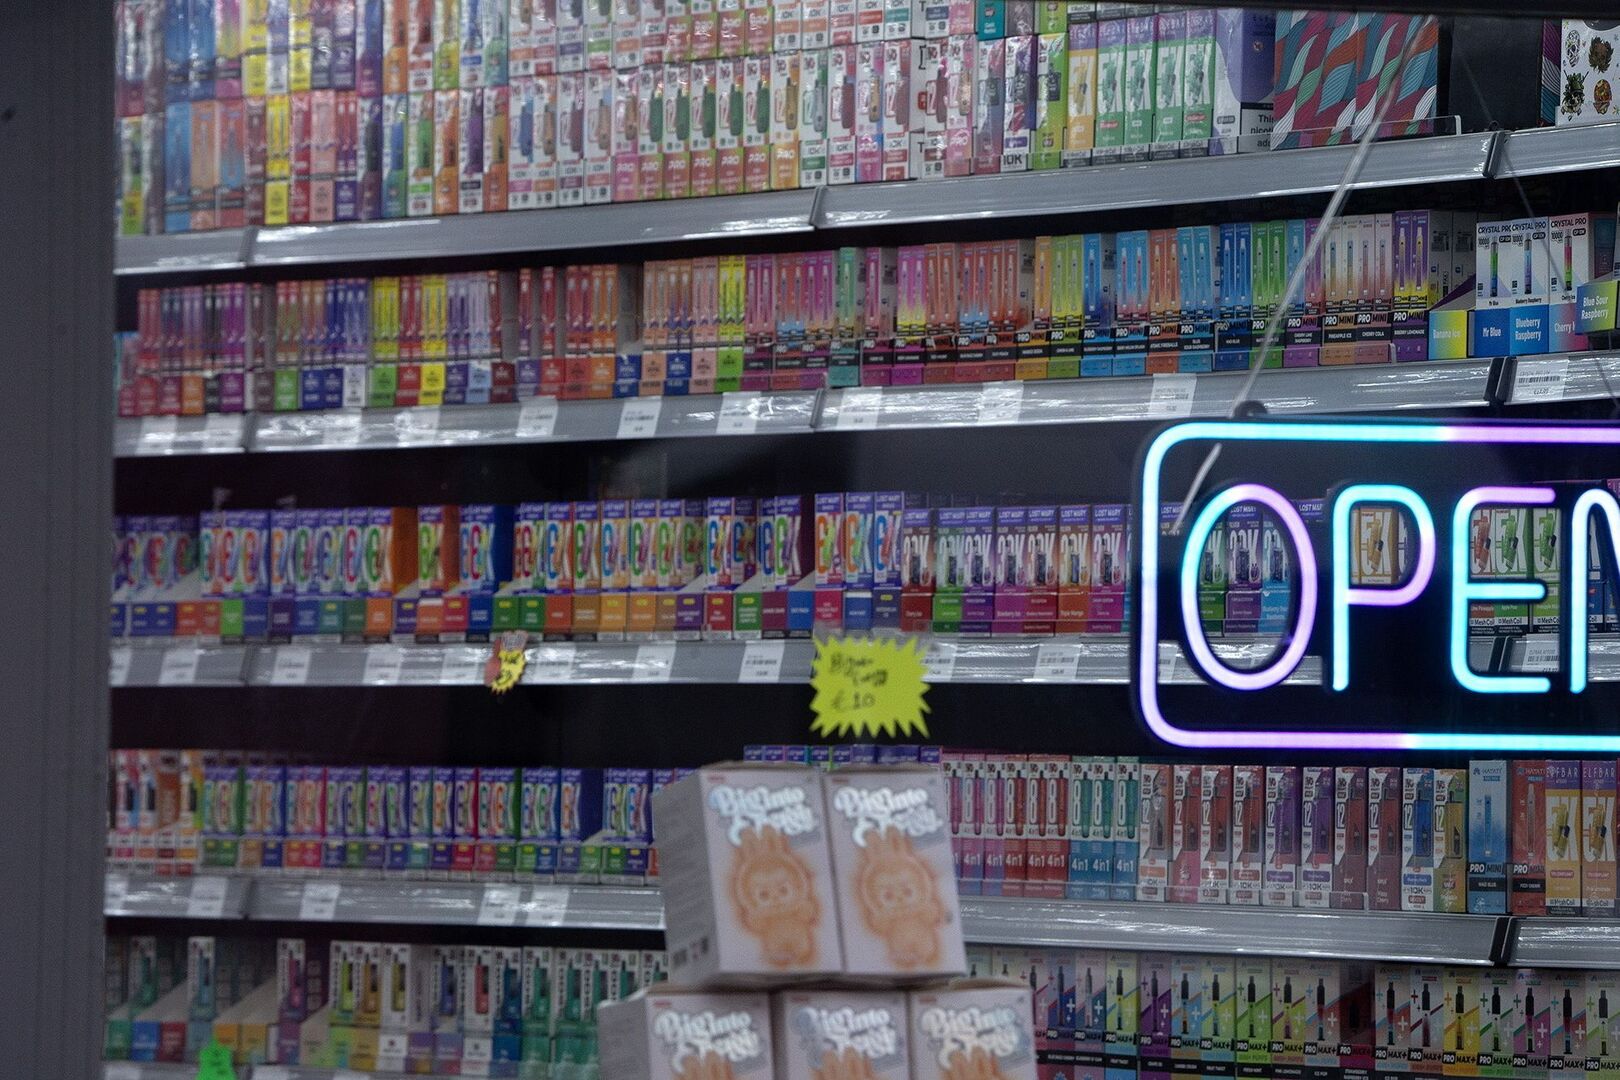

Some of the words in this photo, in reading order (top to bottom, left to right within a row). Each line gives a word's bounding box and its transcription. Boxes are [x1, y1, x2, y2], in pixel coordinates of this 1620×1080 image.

[1003, 154, 1023, 166] 10K
[1512, 224, 1533, 232] CRYSTAL
[1535, 221, 1546, 230] PRO
[1551, 220, 1573, 228] CRYSTAL
[1575, 217, 1586, 226] PRO
[1478, 226, 1500, 234] CRYSTAL
[1583, 297, 1595, 307] Blue
[1596, 295, 1609, 305] Sour
[1357, 314, 1371, 323] PRO
[1393, 312, 1407, 321] PRO
[1581, 309, 1609, 321] Raspberry
[1252, 320, 1264, 330] PRO
[1288, 318, 1300, 328] PRO
[1325, 316, 1337, 325] PRO
[1515, 318, 1541, 328] Blueberry
[1149, 326, 1160, 335] PRO
[1181, 324, 1194, 334] PRO
[1482, 327, 1489, 337] Mr
[1490, 327, 1501, 337] Blue
[1554, 322, 1571, 333] Cherry
[1515, 330, 1542, 342] Raspberry
[1094, 509, 1107, 517] LOST
[1502, 617, 1522, 625] MeshCoil
[1583, 768, 1616, 778] ELFBAR
[1005, 854, 1023, 867] 4in1
[1028, 855, 1045, 867] 4in1
[1047, 854, 1065, 867] 4in1
[1072, 859, 1088, 871] 4in1
[1092, 859, 1110, 871] 4in1
[1116, 859, 1134, 872] 4in1
[1469, 863, 1484, 873] PRO
[1513, 864, 1528, 874] PRO
[1237, 1042, 1248, 1051] PRO
[1272, 1043, 1283, 1052] PRO
[1305, 1045, 1317, 1054] PRO
[1318, 1046, 1337, 1054] MAX+
[1340, 1046, 1352, 1055] PRO
[1375, 1049, 1387, 1058] PRO
[1388, 1051, 1407, 1059] MAX+
[1410, 1051, 1422, 1060] PRO
[1443, 1054, 1455, 1063] PRO
[1456, 1055, 1476, 1064] MAX+
[1480, 1055, 1492, 1064] PRO
[1492, 1056, 1512, 1066] MAX+
[1513, 1057, 1526, 1066] PRO
[1528, 1058, 1547, 1068] MAX+
[1550, 1059, 1563, 1068] PRO
[1564, 1061, 1584, 1069] MAX+
[1586, 1061, 1599, 1070] PRO
